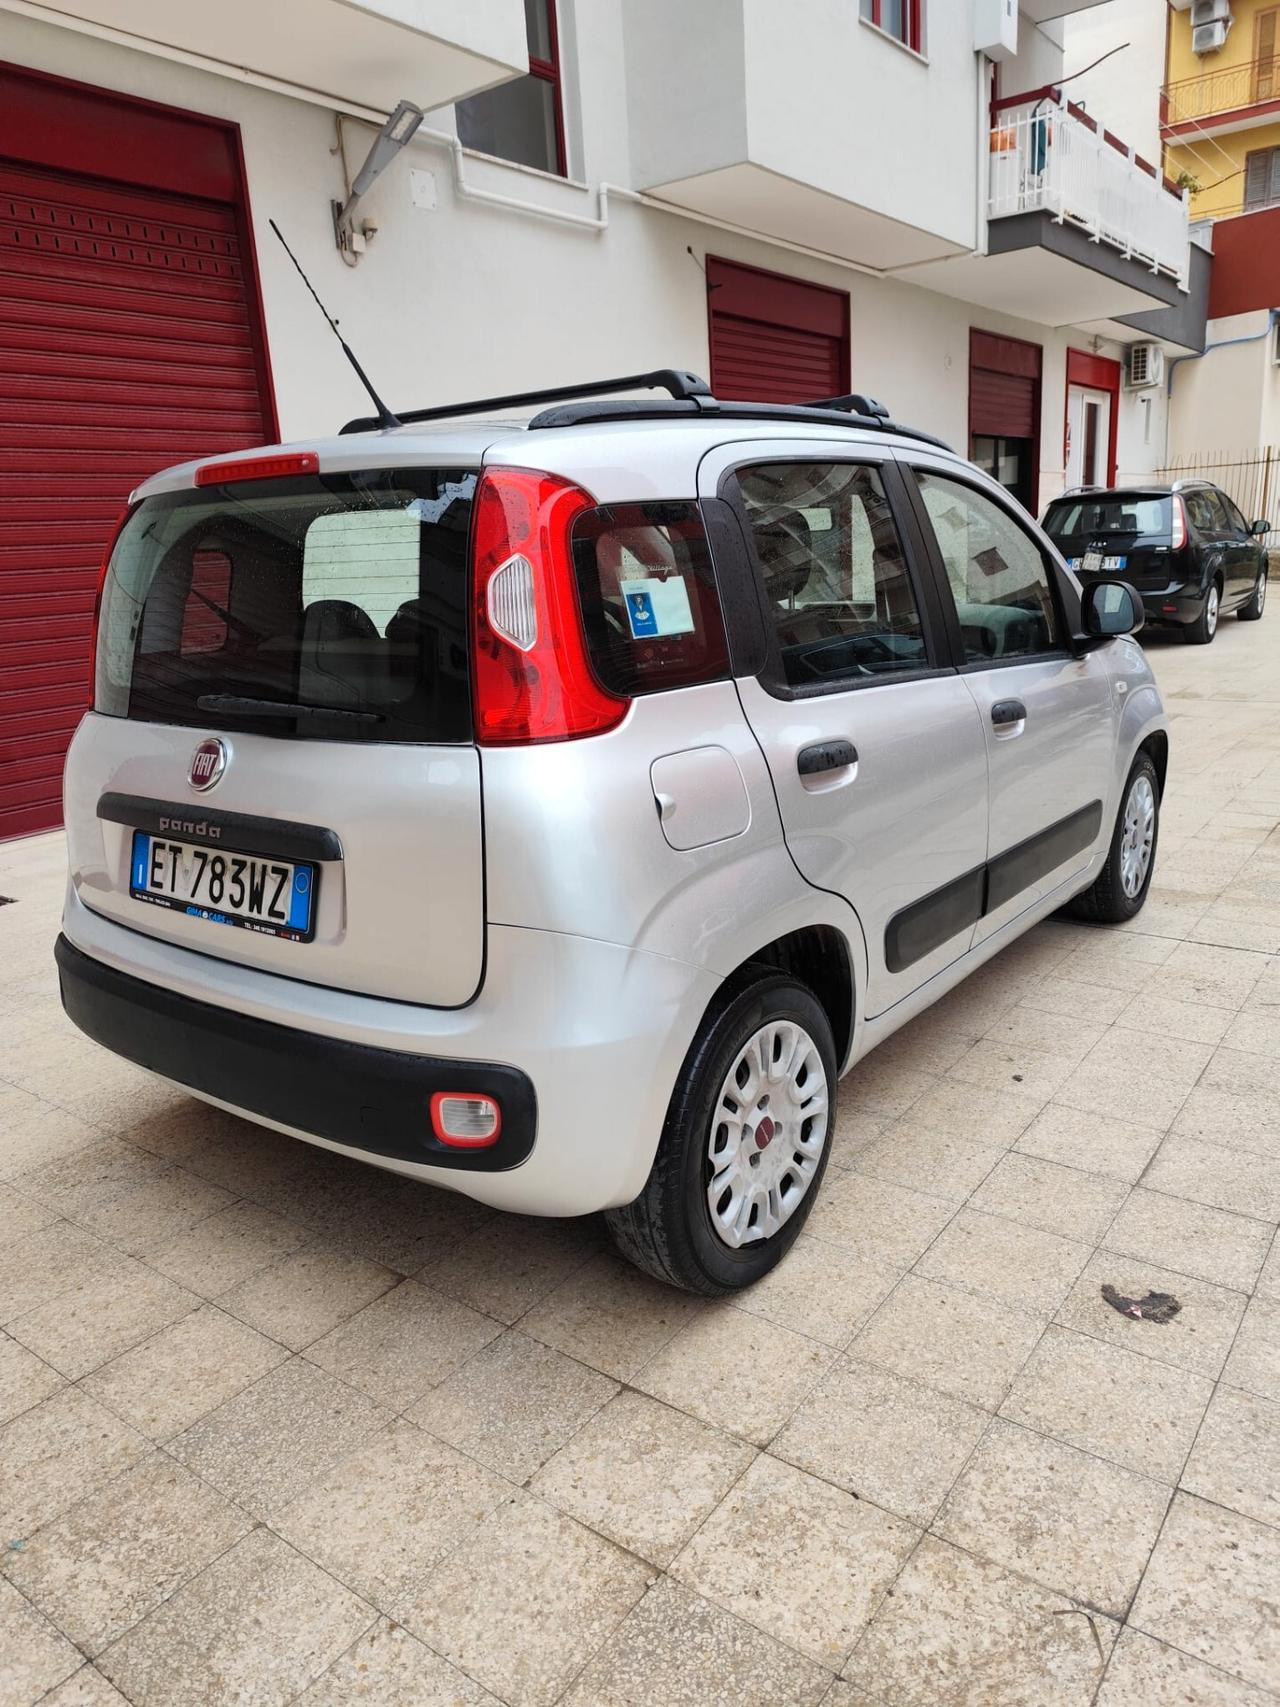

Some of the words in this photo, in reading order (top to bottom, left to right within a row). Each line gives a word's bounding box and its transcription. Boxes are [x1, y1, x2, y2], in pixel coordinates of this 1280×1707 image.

[192, 752, 217, 776] FIAT
[159, 816, 221, 839] panda
[150, 841, 182, 892] ET
[190, 850, 289, 920] 783WZ
